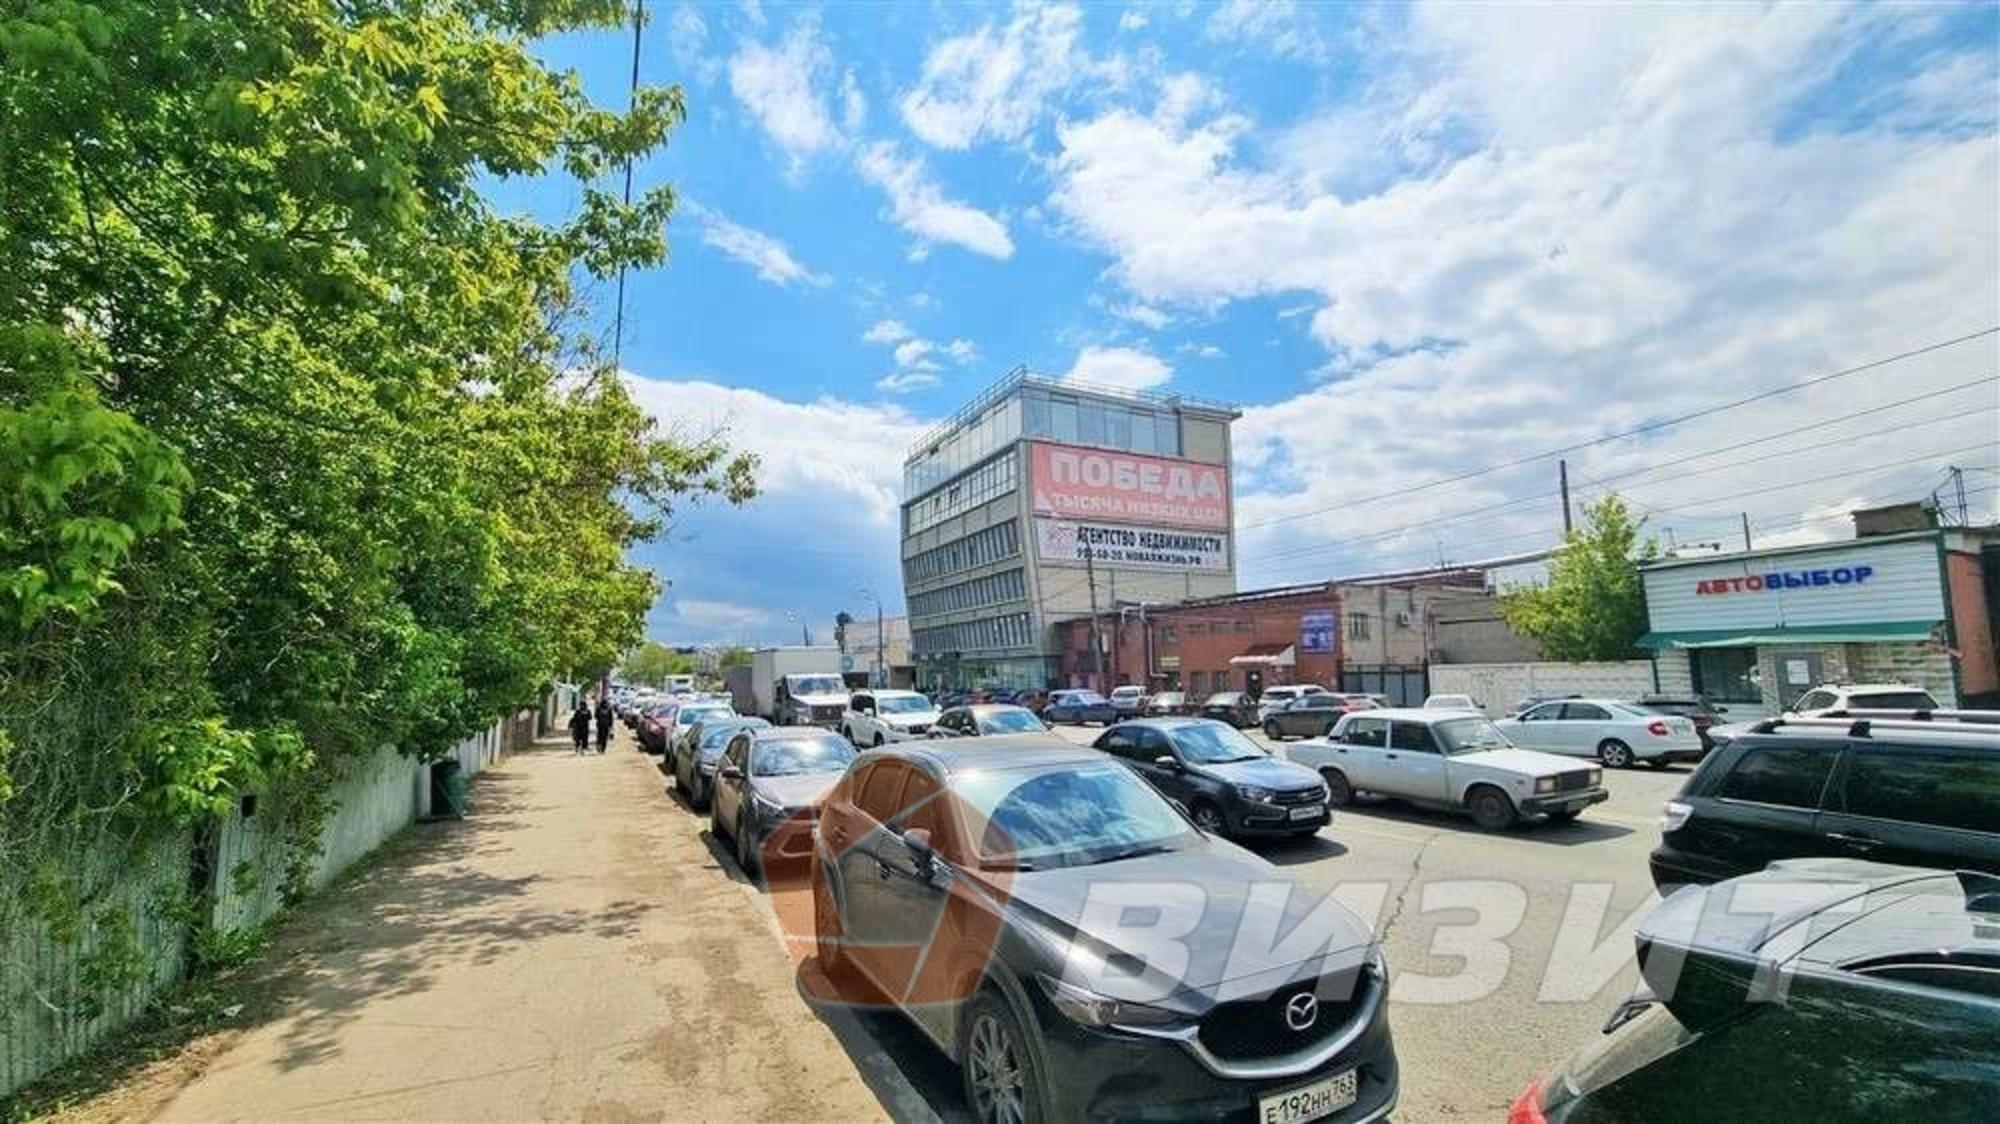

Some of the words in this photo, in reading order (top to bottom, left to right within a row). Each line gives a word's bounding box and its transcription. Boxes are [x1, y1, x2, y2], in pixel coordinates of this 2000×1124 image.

[1051, 451, 1222, 501] ПОБЕДА
[1077, 526, 1137, 547] АГЕНТСТВО
[1139, 531, 1221, 553] НЕДВИЖИМОСТИ
[1696, 566, 1873, 595] АВТОВЫБОР
